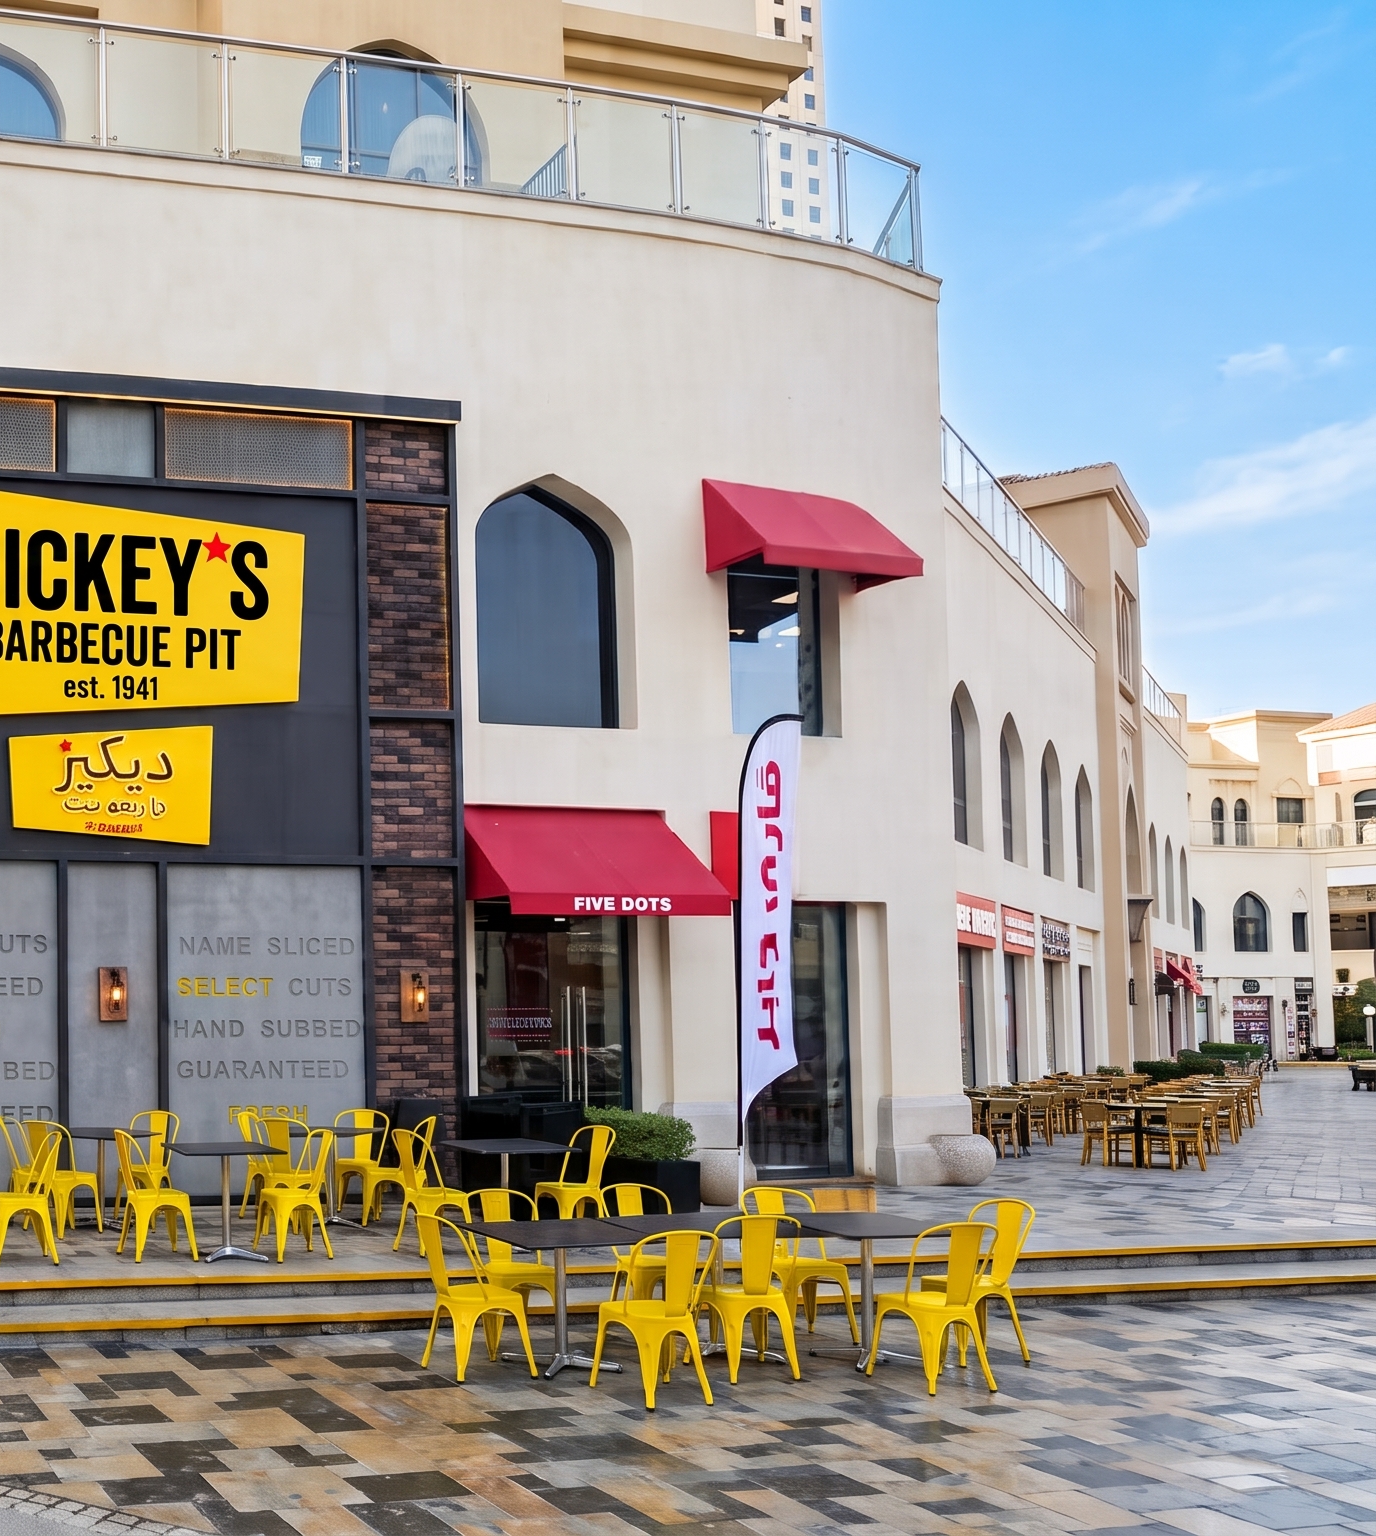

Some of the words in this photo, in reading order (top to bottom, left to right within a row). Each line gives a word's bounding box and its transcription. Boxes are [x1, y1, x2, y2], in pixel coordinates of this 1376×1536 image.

[185, 627, 242, 671] PIT
[63, 676, 105, 700] est.
[112, 675, 159, 701] 1941
[574, 896, 616, 911] FIVE
[621, 896, 672, 912] DOTS
[179, 936, 252, 956] NAME
[267, 937, 355, 956] SLICED
[177, 977, 274, 997] SELECT
[288, 977, 352, 997] CUTS
[173, 1019, 245, 1039] HAND
[261, 1019, 361, 1038] SUBBED
[176, 1060, 350, 1080] GUARANTEED
